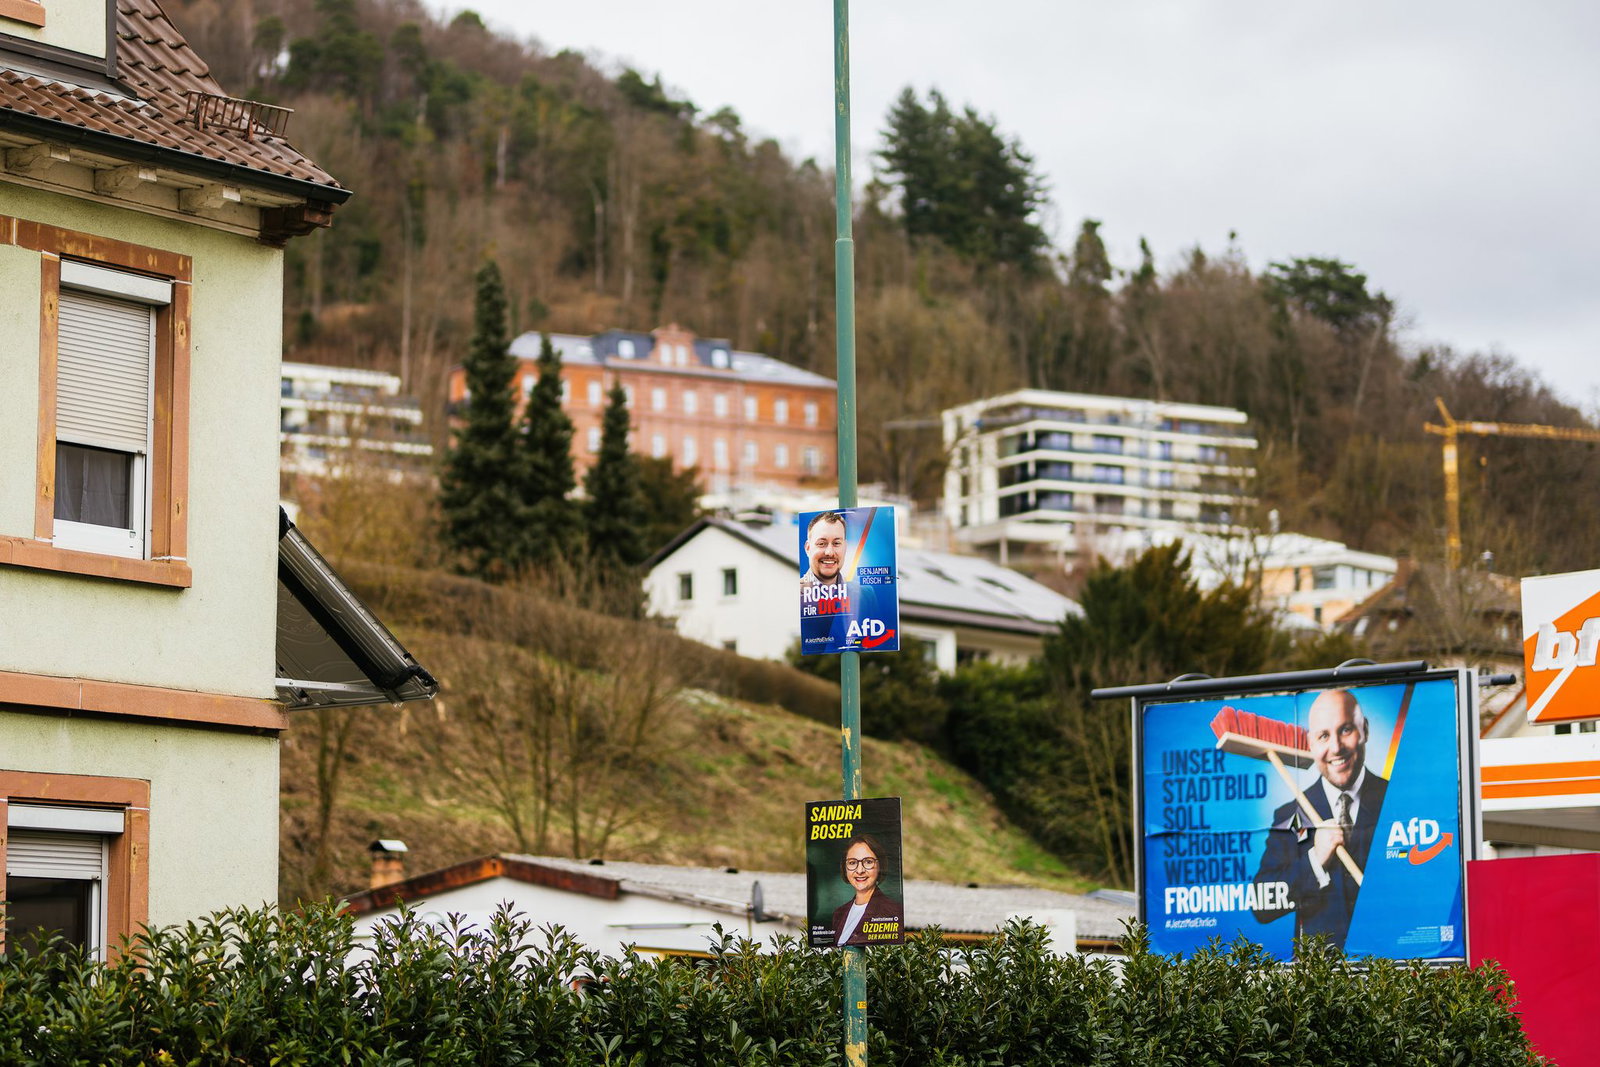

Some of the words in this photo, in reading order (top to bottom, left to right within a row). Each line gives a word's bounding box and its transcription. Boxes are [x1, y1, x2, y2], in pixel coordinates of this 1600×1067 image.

[859, 567, 889, 576] BENJAMIN
[862, 576, 882, 585] RÖSCH
[803, 582, 847, 603] RÖSCH
[803, 604, 817, 617] FÜR
[818, 597, 851, 615] DICH
[846, 618, 886, 637] AfD
[1162, 749, 1226, 777] UNSER
[1162, 772, 1268, 804] STADTBILD
[810, 804, 862, 823] SANDRA
[1163, 804, 1211, 831] SOLL
[811, 823, 853, 841] BOSER
[1386, 817, 1440, 847] AfD
[1163, 831, 1252, 858] SCHÖNER
[1386, 850, 1399, 859] BW
[1164, 856, 1253, 886] WERDEN.
[1164, 881, 1296, 915] FROHNMAIER.
[862, 921, 899, 933] ÖZDEMIR
